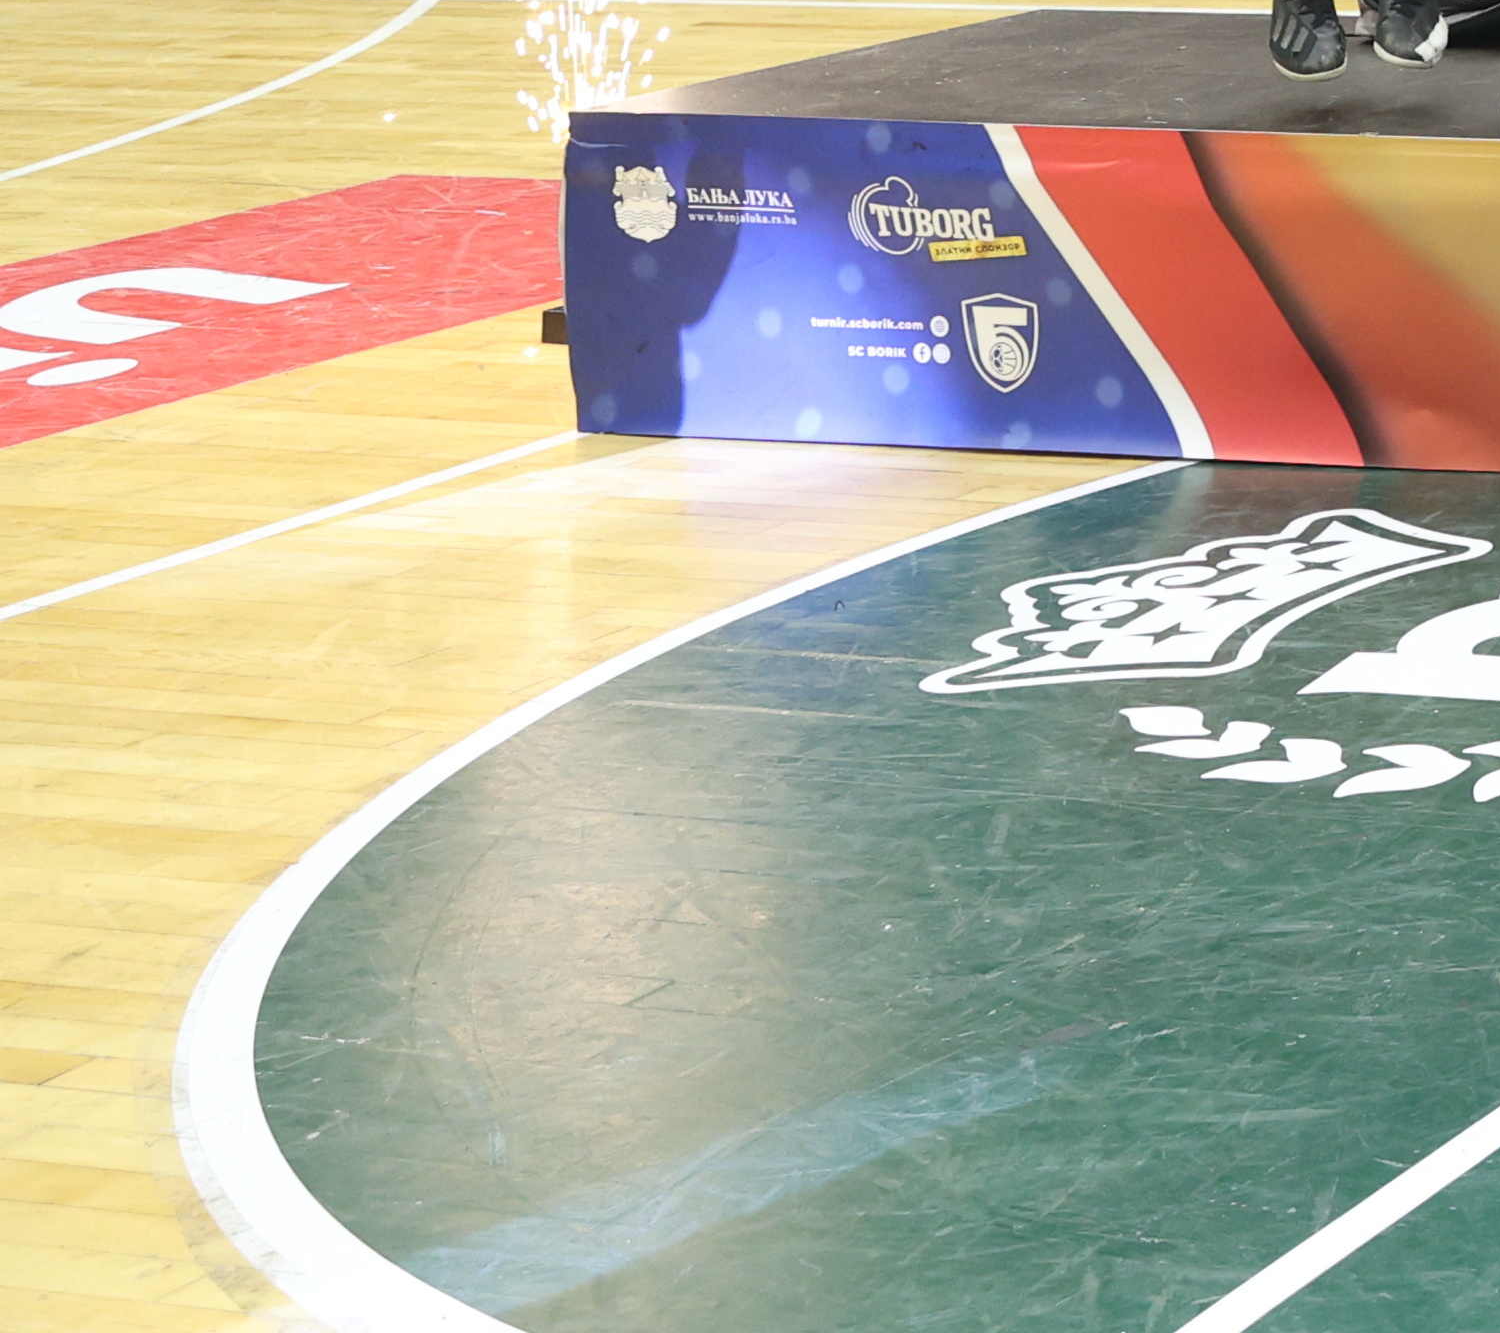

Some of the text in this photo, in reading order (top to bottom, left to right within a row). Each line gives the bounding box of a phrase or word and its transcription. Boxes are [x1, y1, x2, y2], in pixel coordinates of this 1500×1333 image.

[687, 186, 795, 209] БАЊА ЛУКА
[869, 202, 995, 243] TUBORG
[810, 316, 925, 332] turnir.scborik.com
[847, 345, 908, 359] SC BORIK
